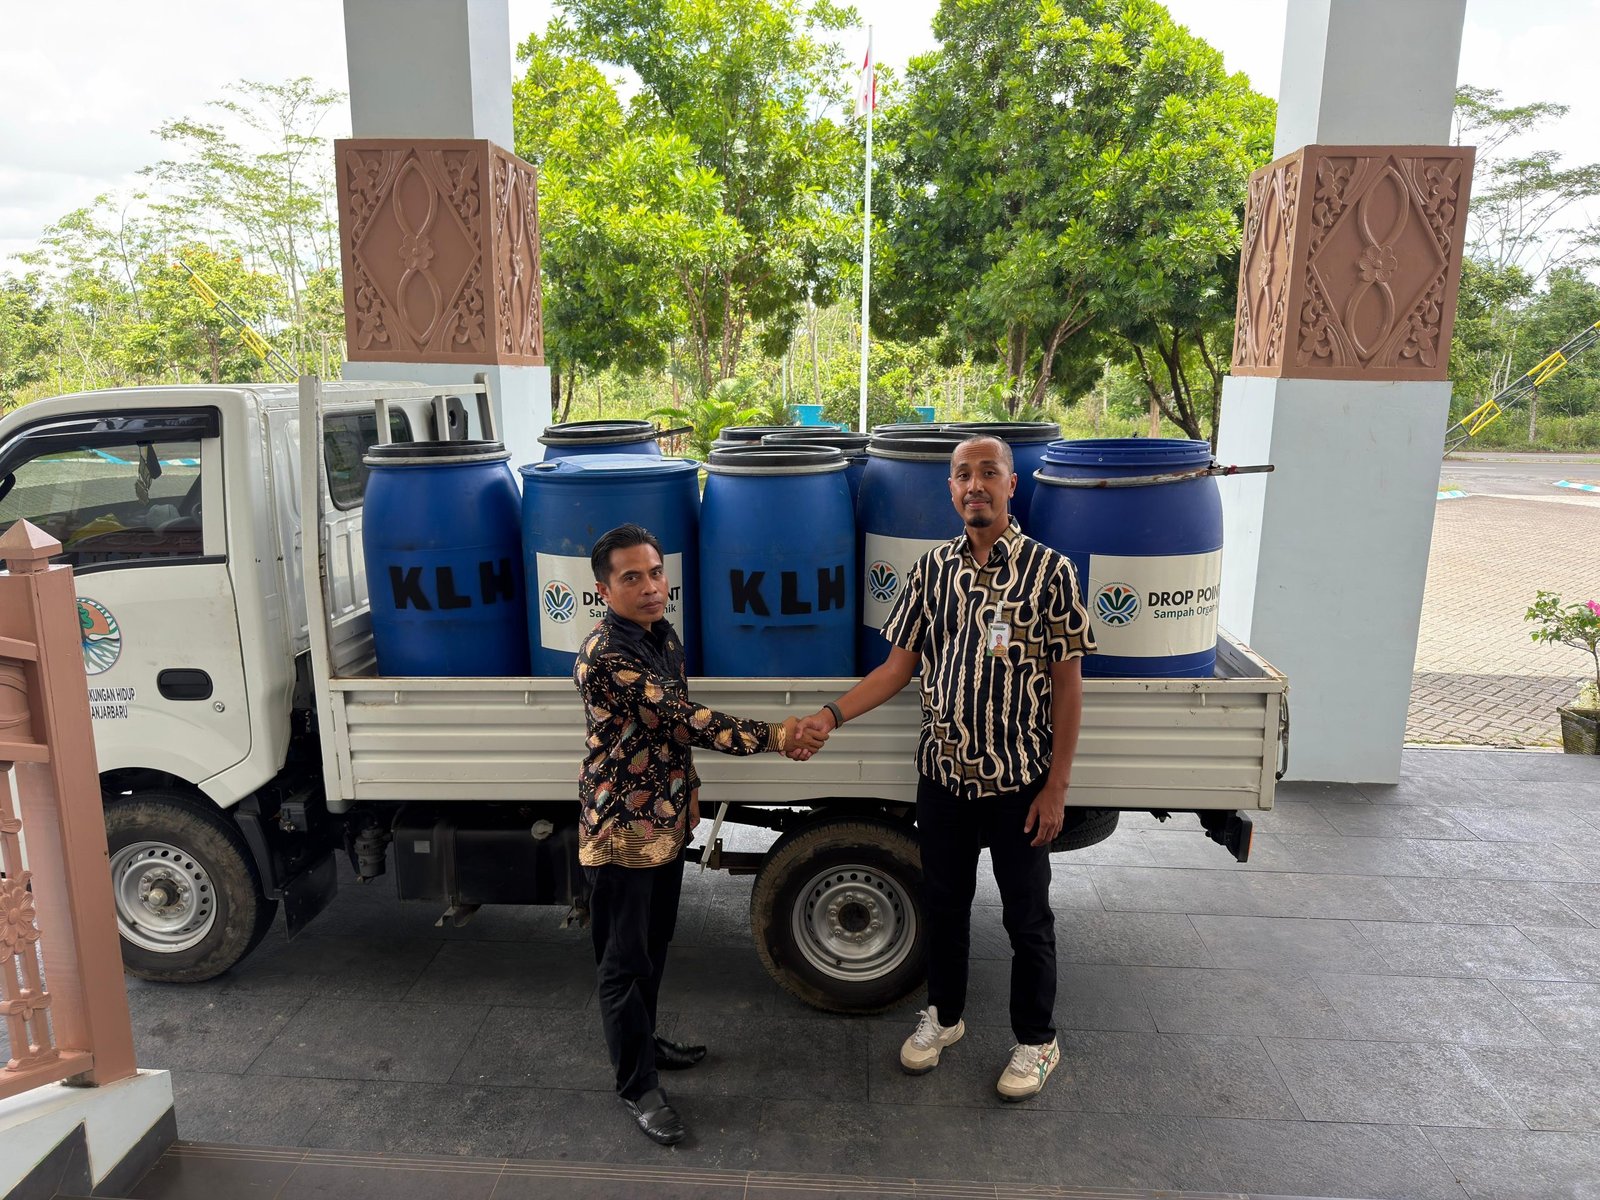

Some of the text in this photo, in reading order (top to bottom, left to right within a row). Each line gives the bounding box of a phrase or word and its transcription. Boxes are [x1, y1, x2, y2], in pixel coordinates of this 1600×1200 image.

[388, 557, 514, 611] KLH
[729, 565, 845, 616] KLH
[583, 591, 607, 606] DR
[1148, 583, 1220, 607] DROP POIN
[1154, 607, 1194, 620] Sampah
[88, 687, 135, 702] KUNGAN HIDUP
[91, 704, 128, 719] ANJARBARU
